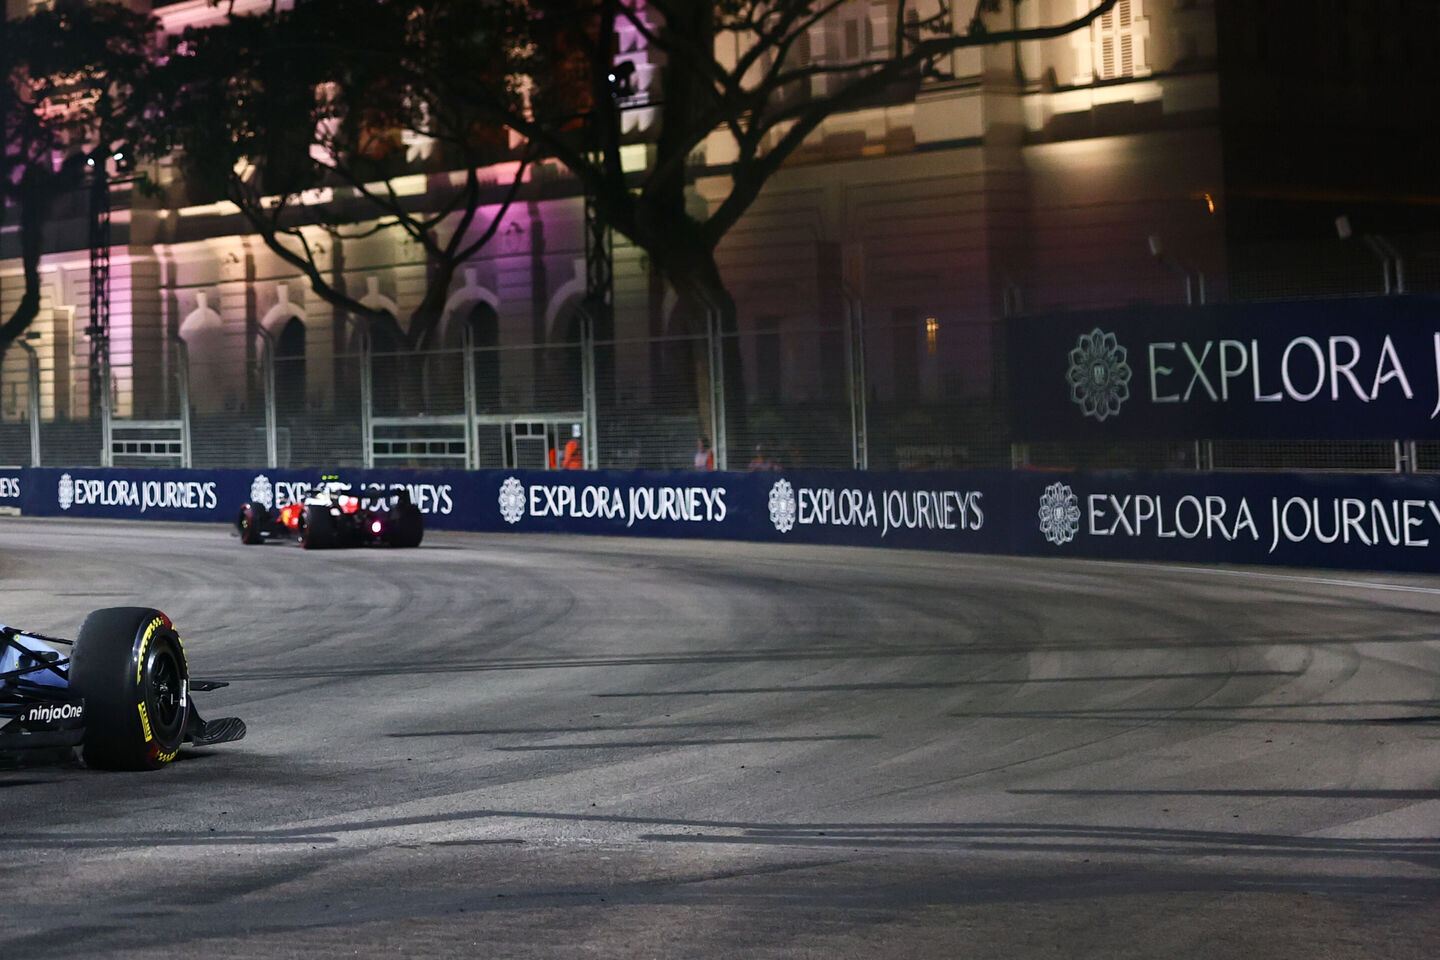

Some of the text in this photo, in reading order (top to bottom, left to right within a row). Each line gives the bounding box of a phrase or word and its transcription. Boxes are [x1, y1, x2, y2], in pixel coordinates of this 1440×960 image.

[1149, 334, 1414, 403] EXPLORA
[74, 479, 217, 513] EXPLORA JOURNEYS
[529, 485, 727, 527] EXPLORA JOURNEYS
[798, 488, 984, 538] EXPLORA JOURNEYS
[1088, 493, 1259, 541] EXPLORA
[28, 703, 83, 724] ninjaOne
